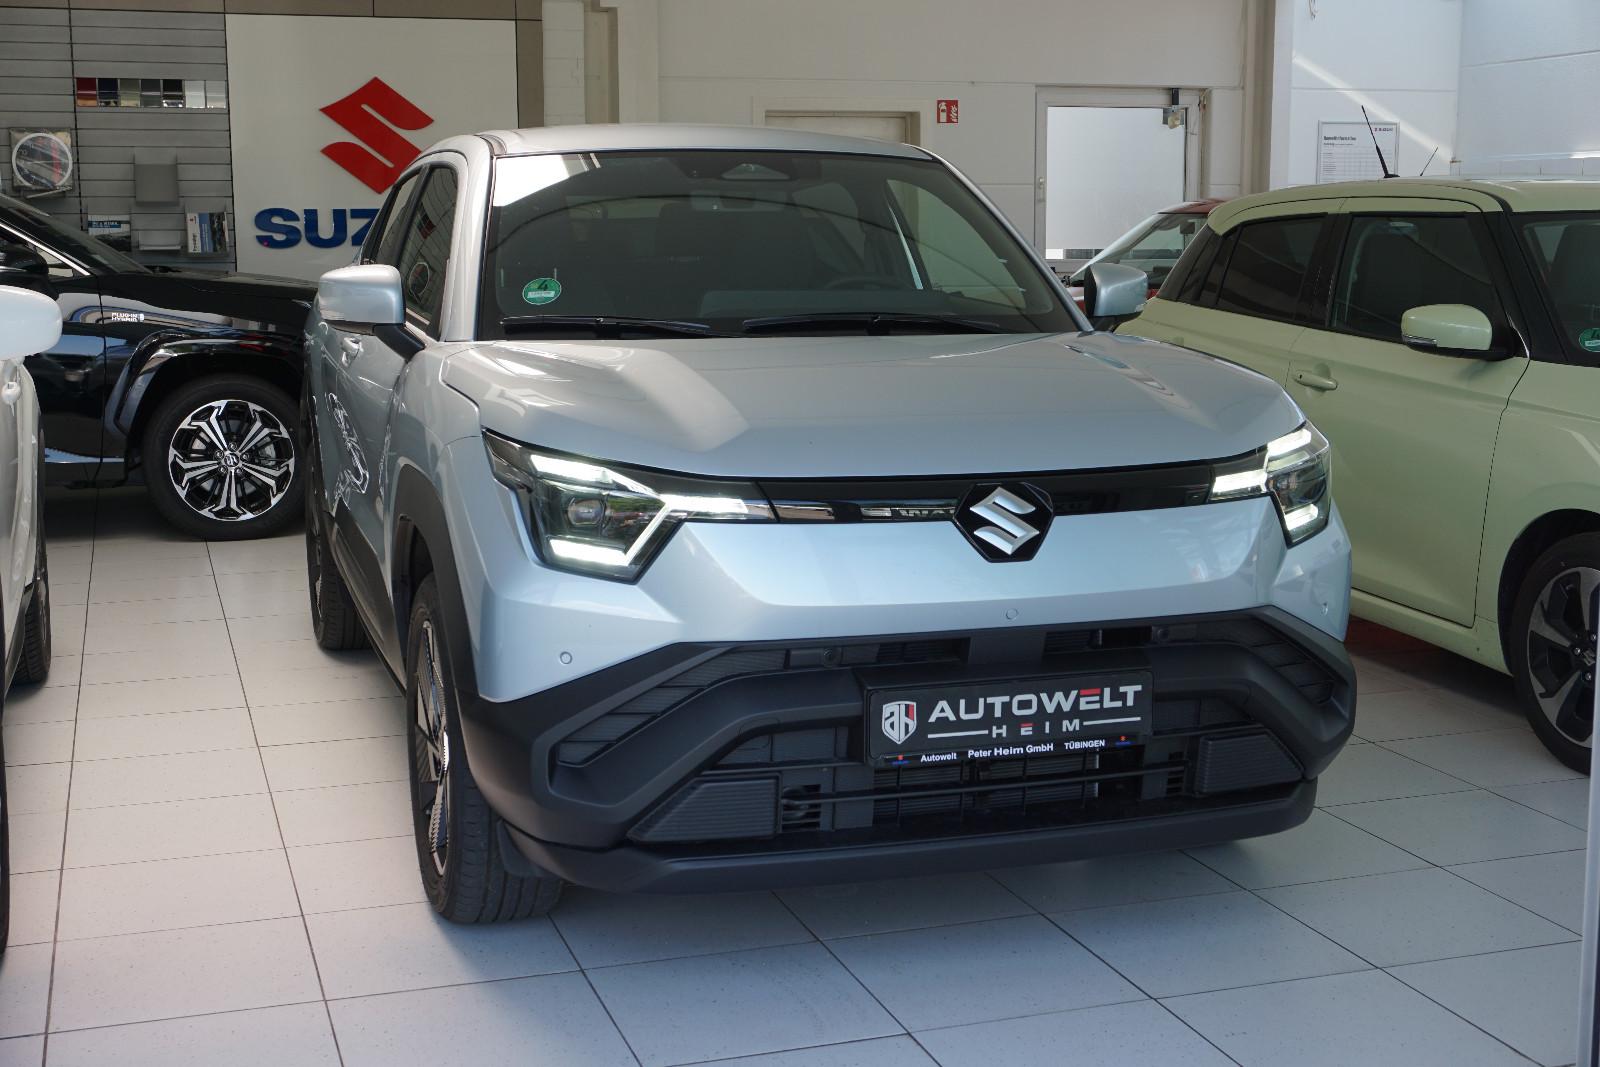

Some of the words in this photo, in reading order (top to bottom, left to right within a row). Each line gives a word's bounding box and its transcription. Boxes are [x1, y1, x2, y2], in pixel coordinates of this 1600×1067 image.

[537, 279, 548, 291] 4
[928, 685, 1142, 723] AUTOWELT
[920, 752, 957, 763] Autowelt
[967, 749, 992, 759] Peter
[993, 746, 1024, 756] Heim
[1025, 743, 1055, 754] GmbH
[1064, 740, 1106, 750] TÜBINGEN
